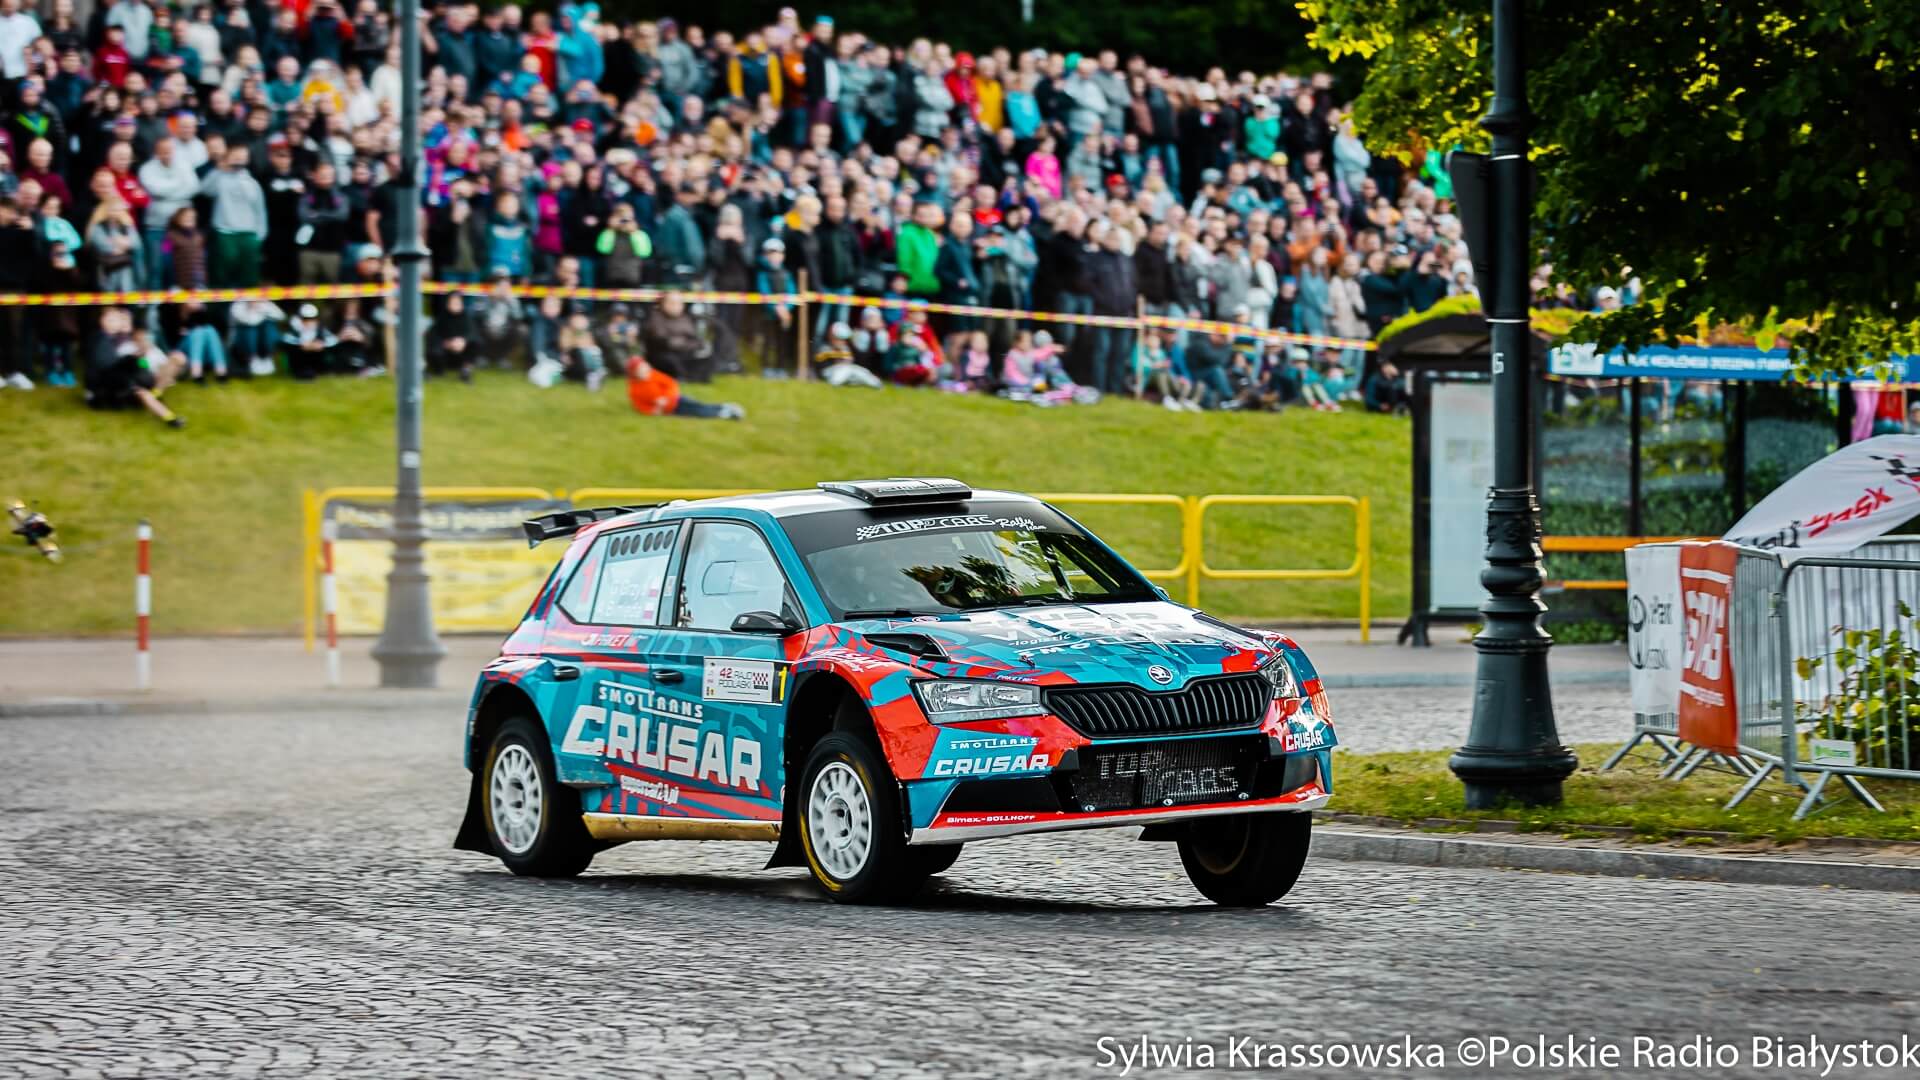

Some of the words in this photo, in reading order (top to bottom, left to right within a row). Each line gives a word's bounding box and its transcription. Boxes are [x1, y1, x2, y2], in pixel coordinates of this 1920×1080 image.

[999, 516, 1034, 529] Rally
[720, 668, 733, 679] 42
[778, 665, 787, 701] 1
[599, 680, 703, 723] SMOLTRANS
[561, 704, 761, 791] CRUSAR
[950, 737, 1039, 750] SMOLTRANS
[1286, 729, 1325, 751] CRUSAR
[934, 754, 1049, 776] CRUSAR
